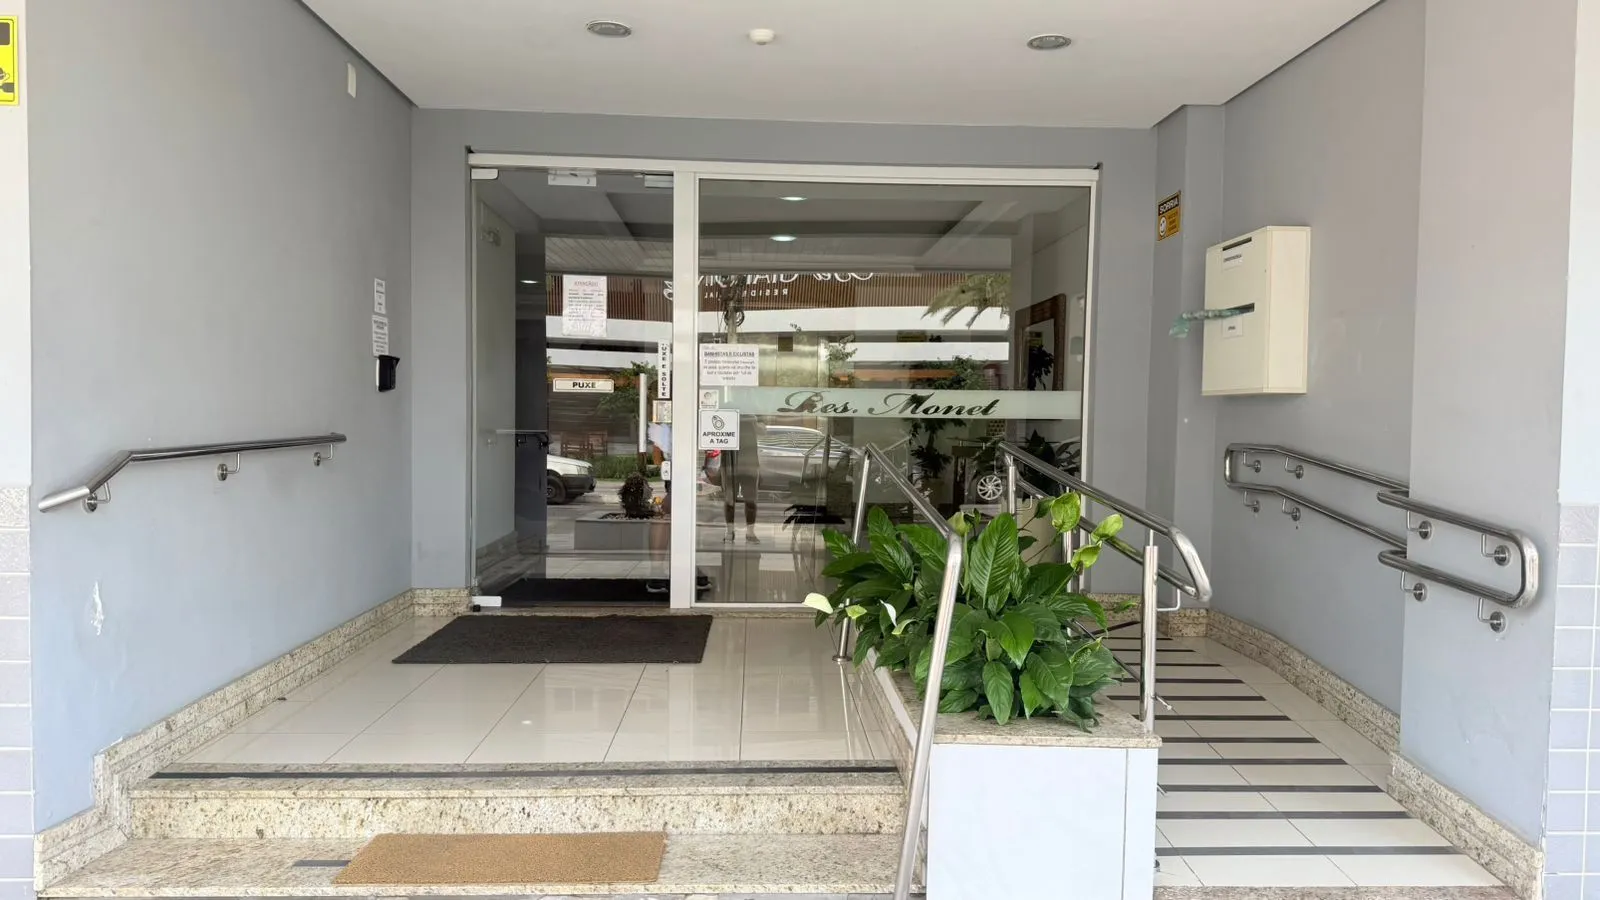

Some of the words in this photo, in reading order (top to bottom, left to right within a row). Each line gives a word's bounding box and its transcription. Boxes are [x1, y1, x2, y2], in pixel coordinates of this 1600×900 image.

[1159, 197, 1179, 214] SORRIA
[572, 381, 597, 389] PUXE
[776, 390, 859, 415] Res.
[867, 391, 1001, 417] Monet
